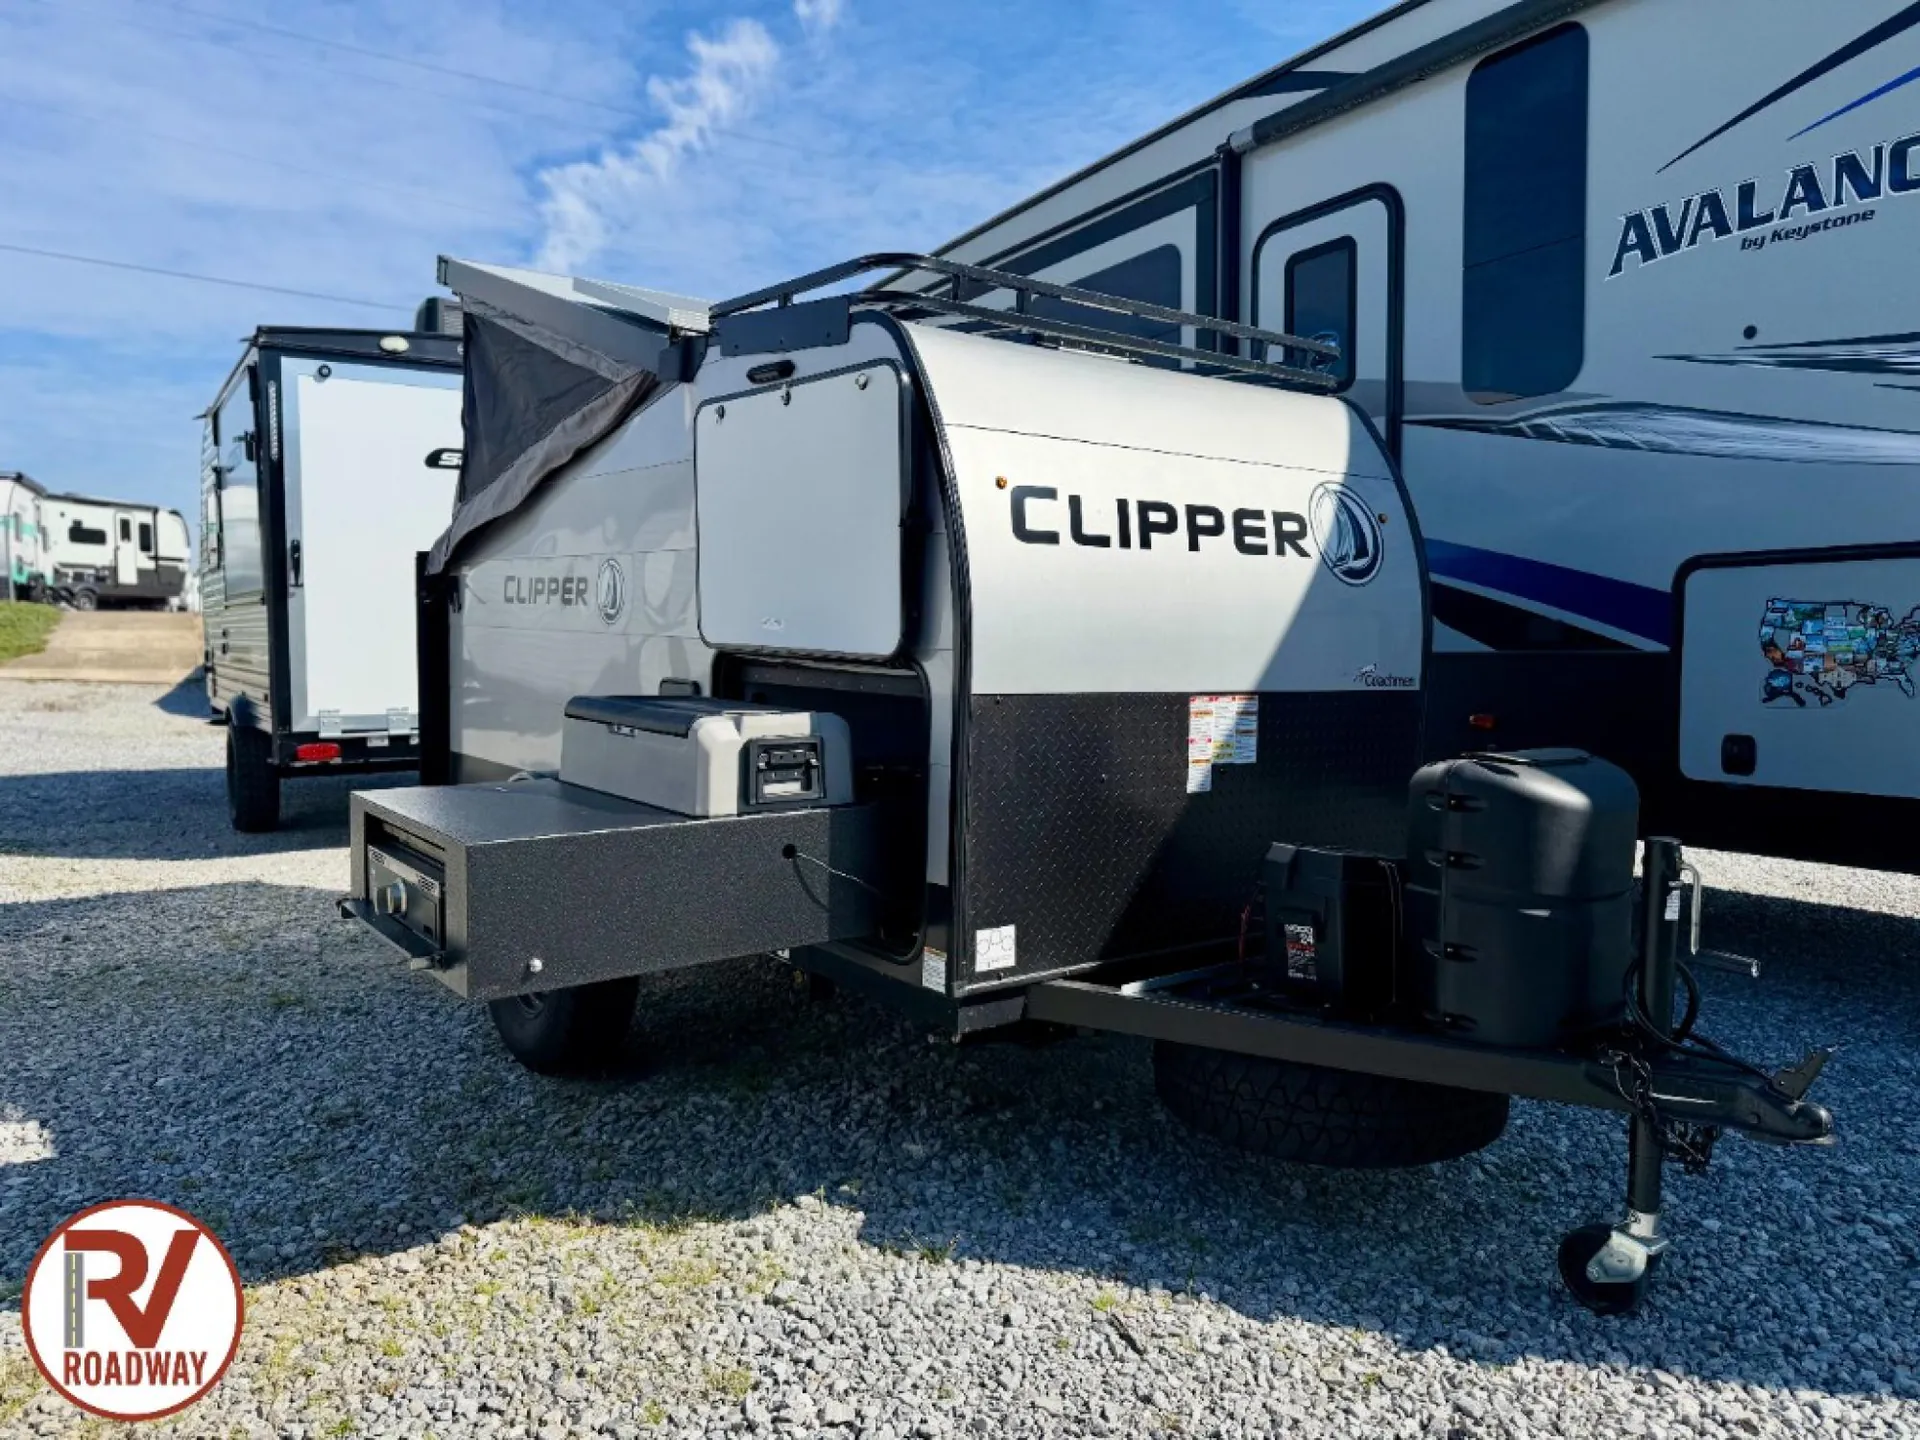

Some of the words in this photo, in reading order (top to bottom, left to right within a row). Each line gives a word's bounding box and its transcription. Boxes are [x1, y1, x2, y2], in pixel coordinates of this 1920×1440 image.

[1740, 235, 1766, 251] by
[1770, 208, 1876, 242] Keystone
[1010, 485, 1312, 558] CLIPPER
[504, 575, 588, 606] CLIPPER
